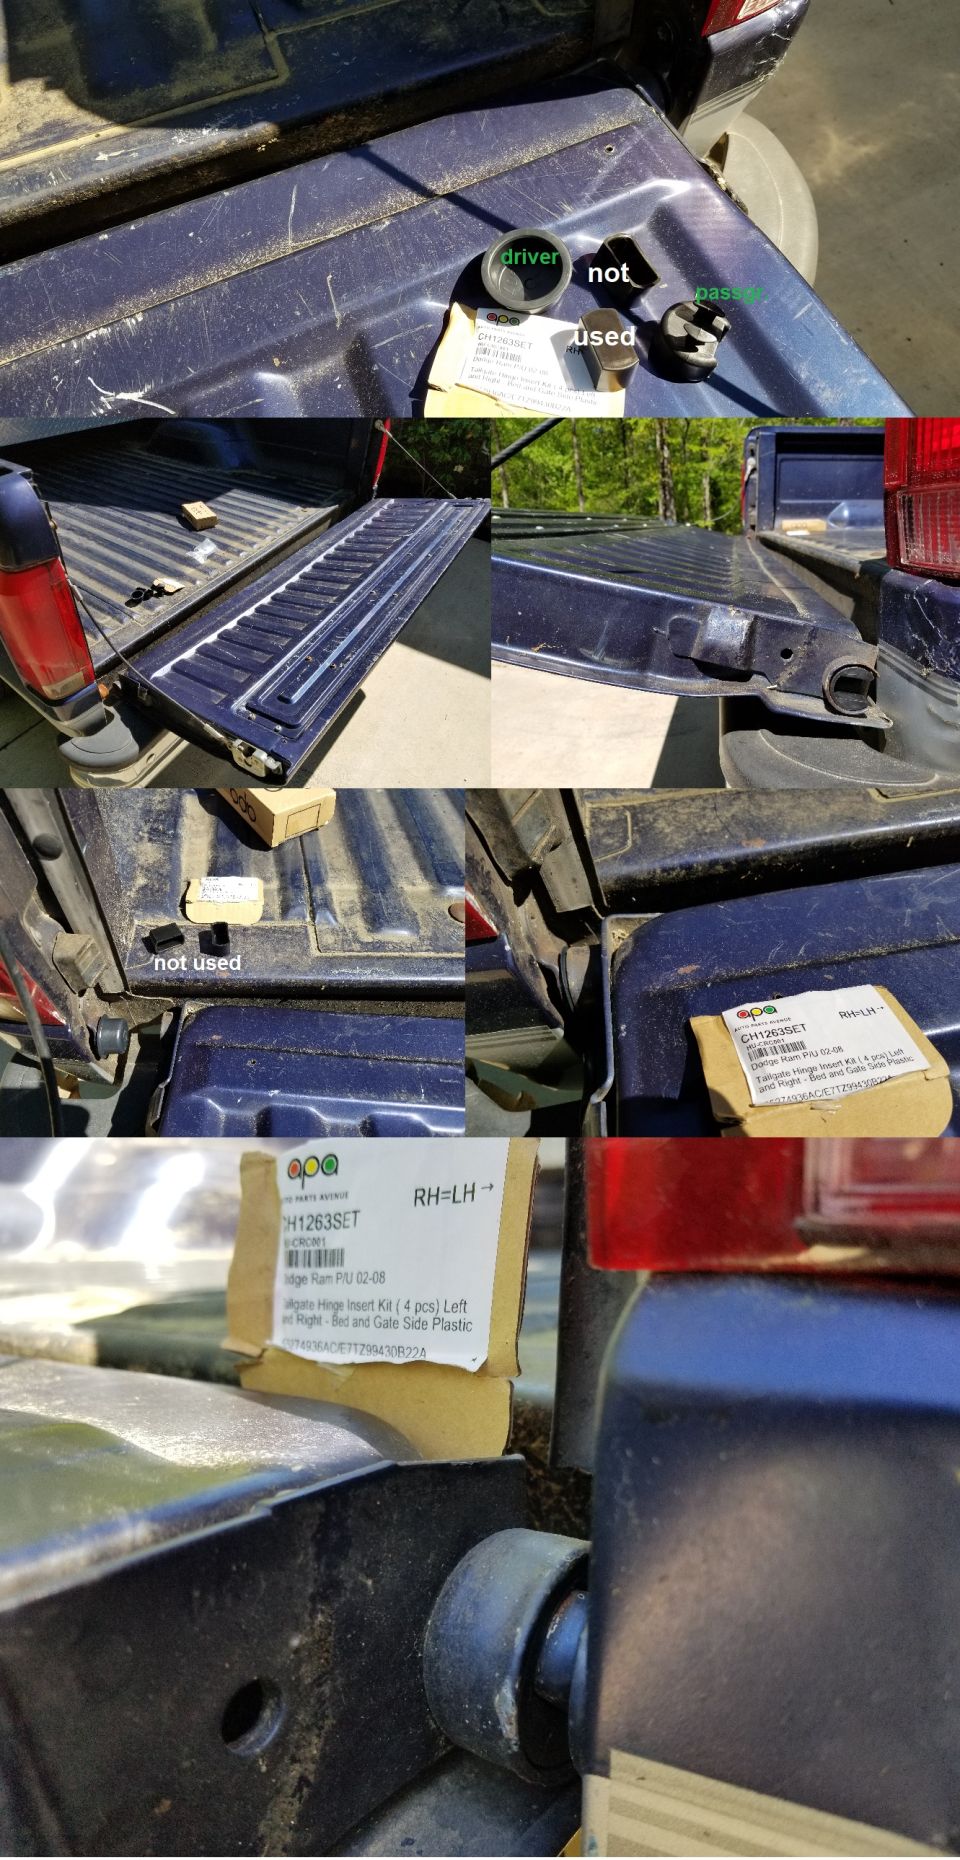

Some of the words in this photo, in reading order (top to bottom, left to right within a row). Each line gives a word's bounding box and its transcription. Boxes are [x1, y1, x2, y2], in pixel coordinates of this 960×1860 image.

[478, 332, 533, 351] CH1263SET
[566, 345, 580, 355] RH
[737, 1005, 777, 1021] apa
[839, 1006, 876, 1020] RH=LH
[741, 1023, 807, 1044] CH1263SET
[751, 1059, 779, 1071] Dodge
[781, 1054, 801, 1063] Ram
[802, 1050, 819, 1059] P/U
[820, 1046, 844, 1056] 02-08
[756, 1071, 791, 1084] Tailgate
[792, 1065, 817, 1075] Hinge
[819, 1060, 843, 1070] Insert
[844, 1057, 857, 1065] Kit
[888, 1048, 904, 1057] Left
[759, 1083, 776, 1094] and
[778, 1078, 801, 1089] Right
[809, 1073, 826, 1082] Bed
[829, 1069, 844, 1078] and
[846, 1065, 867, 1074] Gate
[867, 1060, 886, 1070] Side
[887, 1055, 914, 1066] Plastic
[288, 1153, 339, 1190] apa
[295, 1194, 317, 1202] PARTS
[319, 1191, 349, 1201] AVENUE
[413, 1182, 476, 1207] RH=LH
[310, 1272, 333, 1286] Ram
[335, 1272, 353, 1285] P/U
[356, 1271, 386, 1285] 02-08
[318, 1299, 344, 1314] Hinge
[347, 1299, 374, 1312] Insert
[378, 1299, 392, 1312] Kit
[404, 1299, 410, 1310] 4
[415, 1299, 440, 1316] pcs)
[443, 1299, 467, 1313] Left
[296, 1314, 322, 1329] Right
[332, 1315, 350, 1328] Bed
[352, 1316, 370, 1328] and
[374, 1316, 399, 1329] Gate
[403, 1317, 428, 1330] Side
[432, 1317, 473, 1332] Plastic
